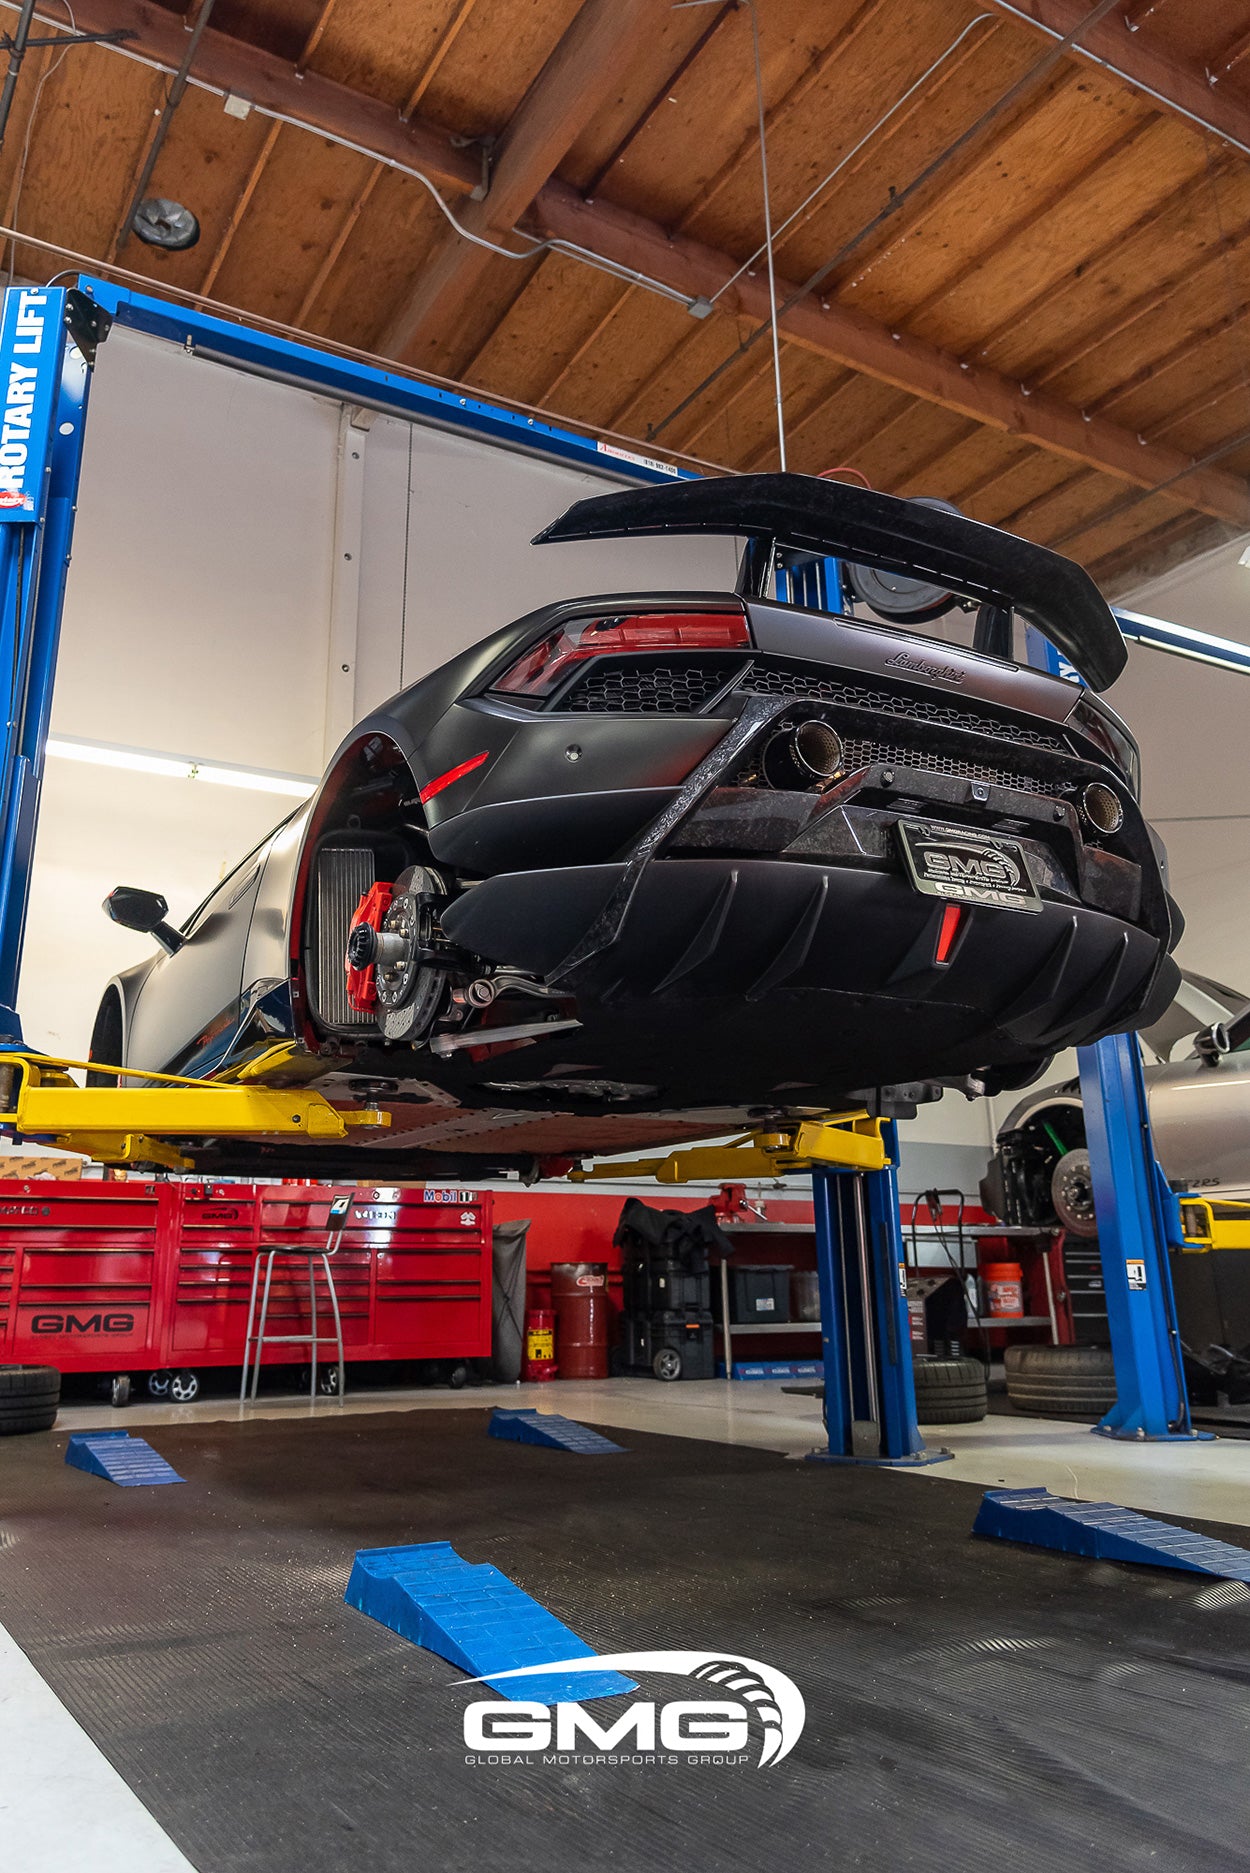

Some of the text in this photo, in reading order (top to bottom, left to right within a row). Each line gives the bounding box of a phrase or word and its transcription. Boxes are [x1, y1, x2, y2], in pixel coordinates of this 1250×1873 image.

[13, 291, 47, 353] LIFT
[885, 651, 967, 683] Lamborghini
[923, 851, 997, 879] GMG
[934, 882, 1027, 905] GMG
[423, 1190, 457, 1203] Mobil
[31, 1313, 135, 1334] GMG
